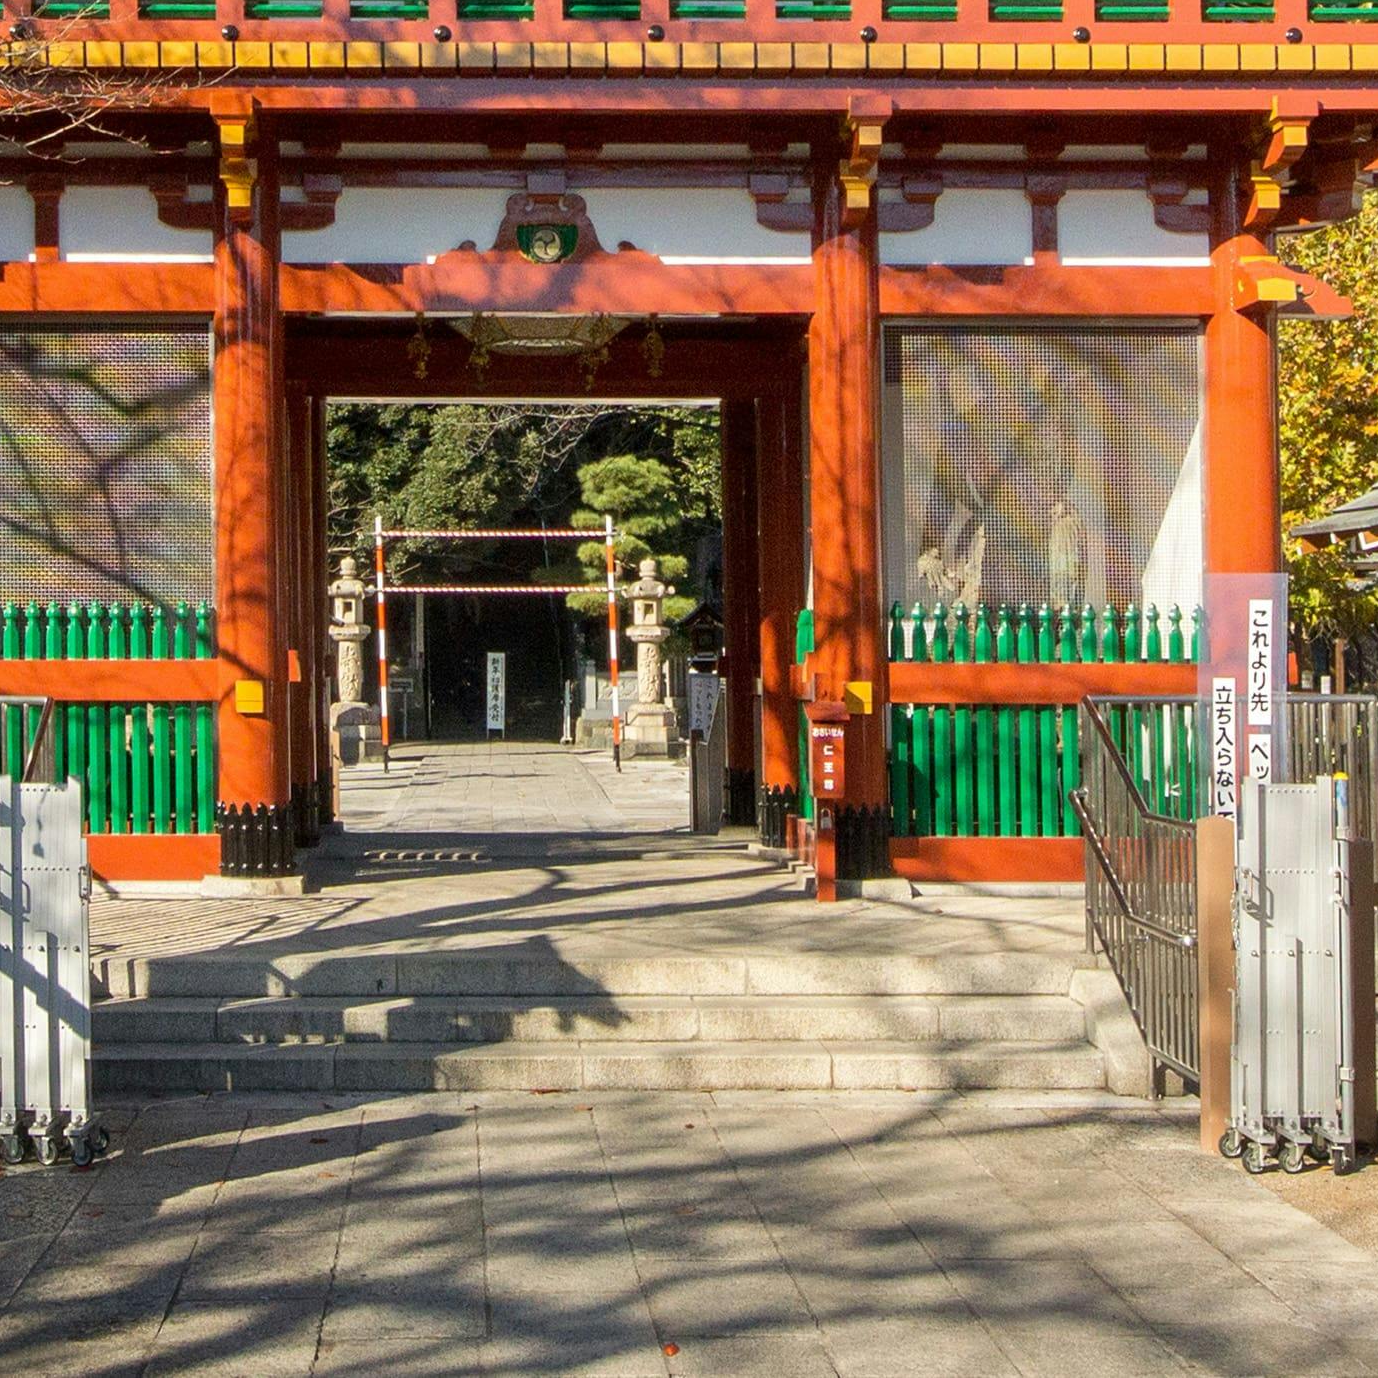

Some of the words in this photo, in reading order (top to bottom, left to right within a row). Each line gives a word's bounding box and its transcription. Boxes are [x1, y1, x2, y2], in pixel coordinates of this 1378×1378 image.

[1251, 609, 1270, 713] これより先
